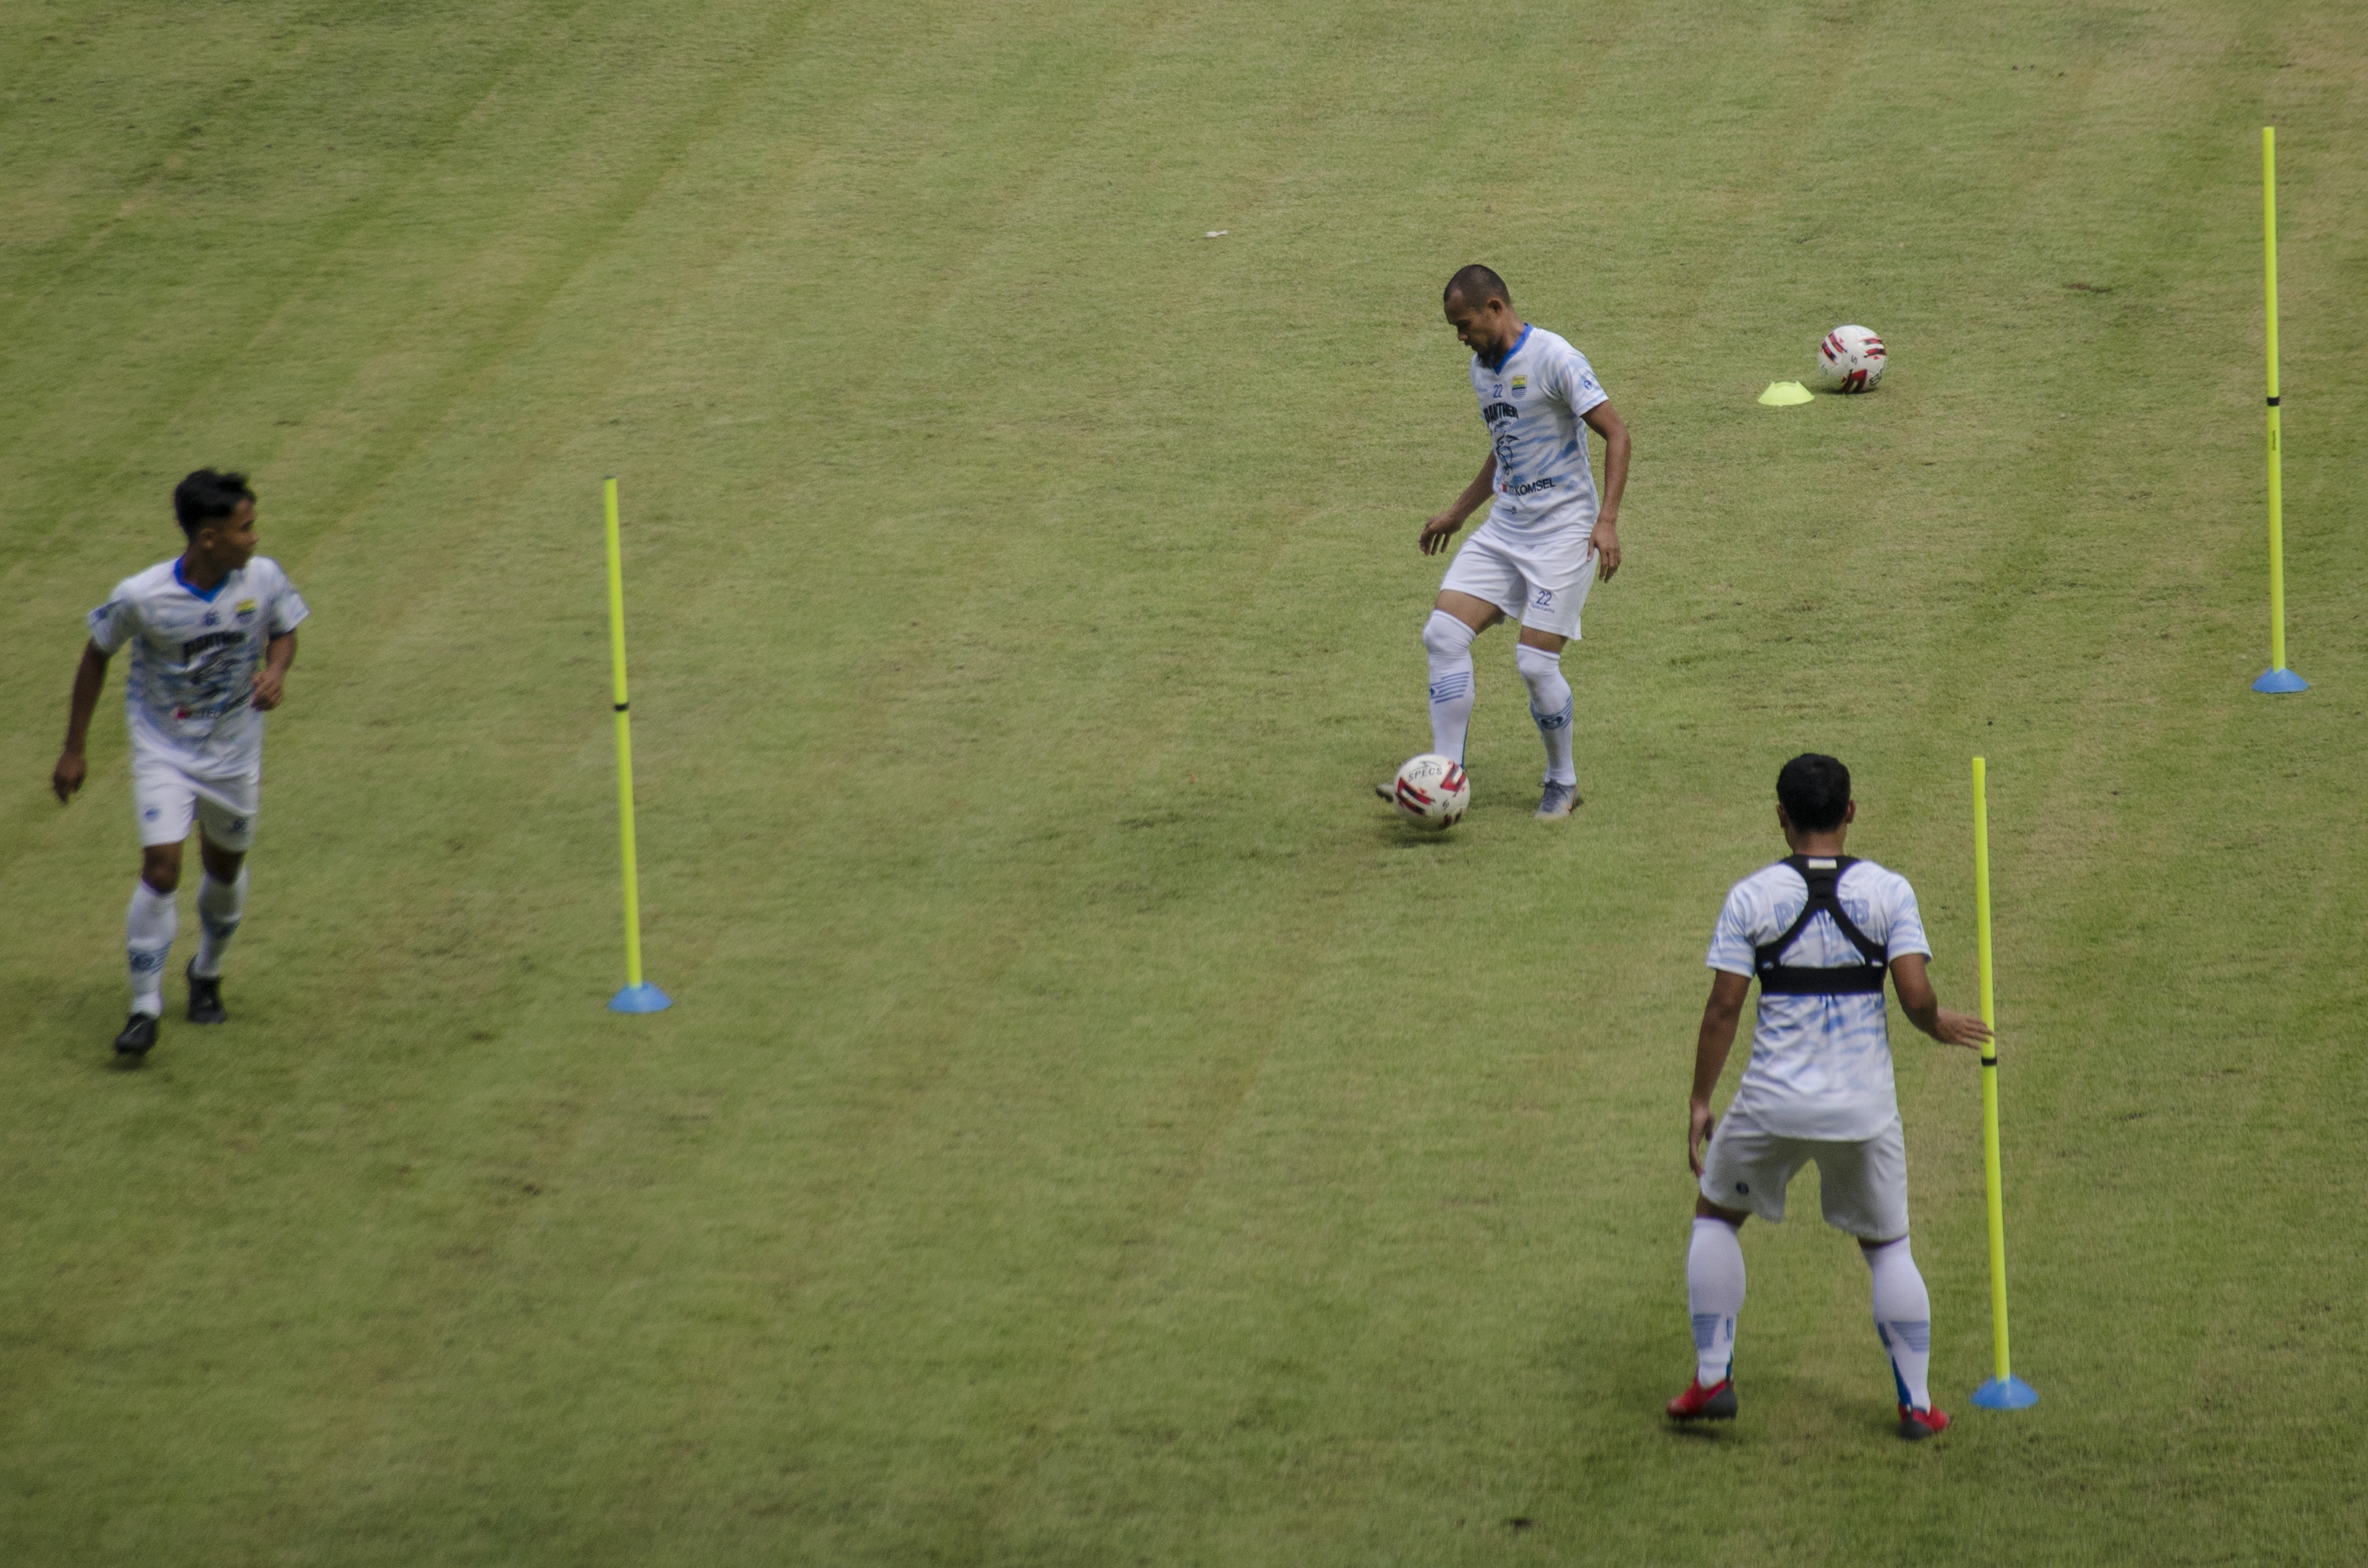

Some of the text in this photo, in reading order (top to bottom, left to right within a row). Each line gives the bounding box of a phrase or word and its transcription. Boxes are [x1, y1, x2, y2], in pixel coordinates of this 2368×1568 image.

[1493, 384, 1503, 398] 22
[1484, 401, 1520, 427] PANTHER
[1509, 477, 1556, 496] KOMSEL
[1536, 590, 1552, 607] 22
[1409, 768, 1442, 781] SPECS
